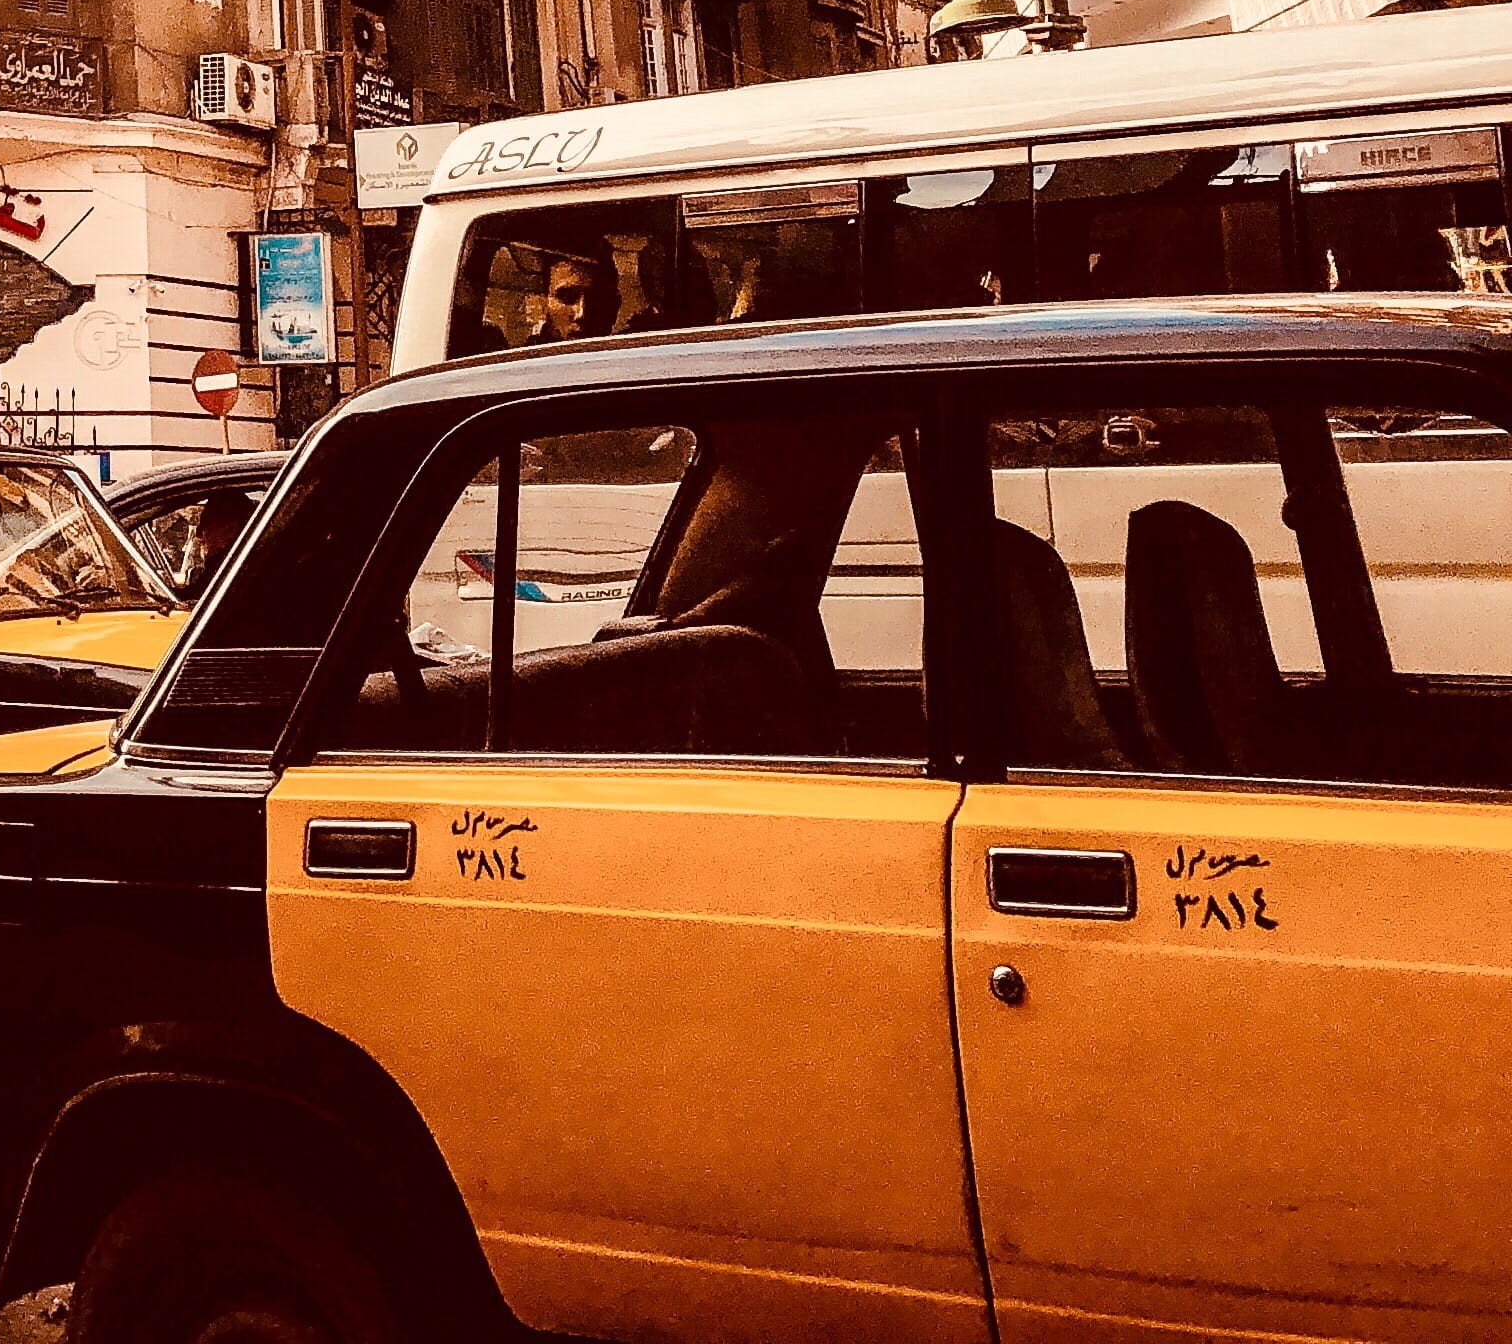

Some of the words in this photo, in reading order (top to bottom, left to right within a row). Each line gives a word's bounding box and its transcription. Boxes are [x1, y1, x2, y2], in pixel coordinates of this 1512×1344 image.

[448, 126, 604, 180] ASLY
[561, 588, 622, 601] RACING
[456, 845, 527, 882] ٣٨١٤
[1174, 887, 1280, 932] ٣٨١٤
